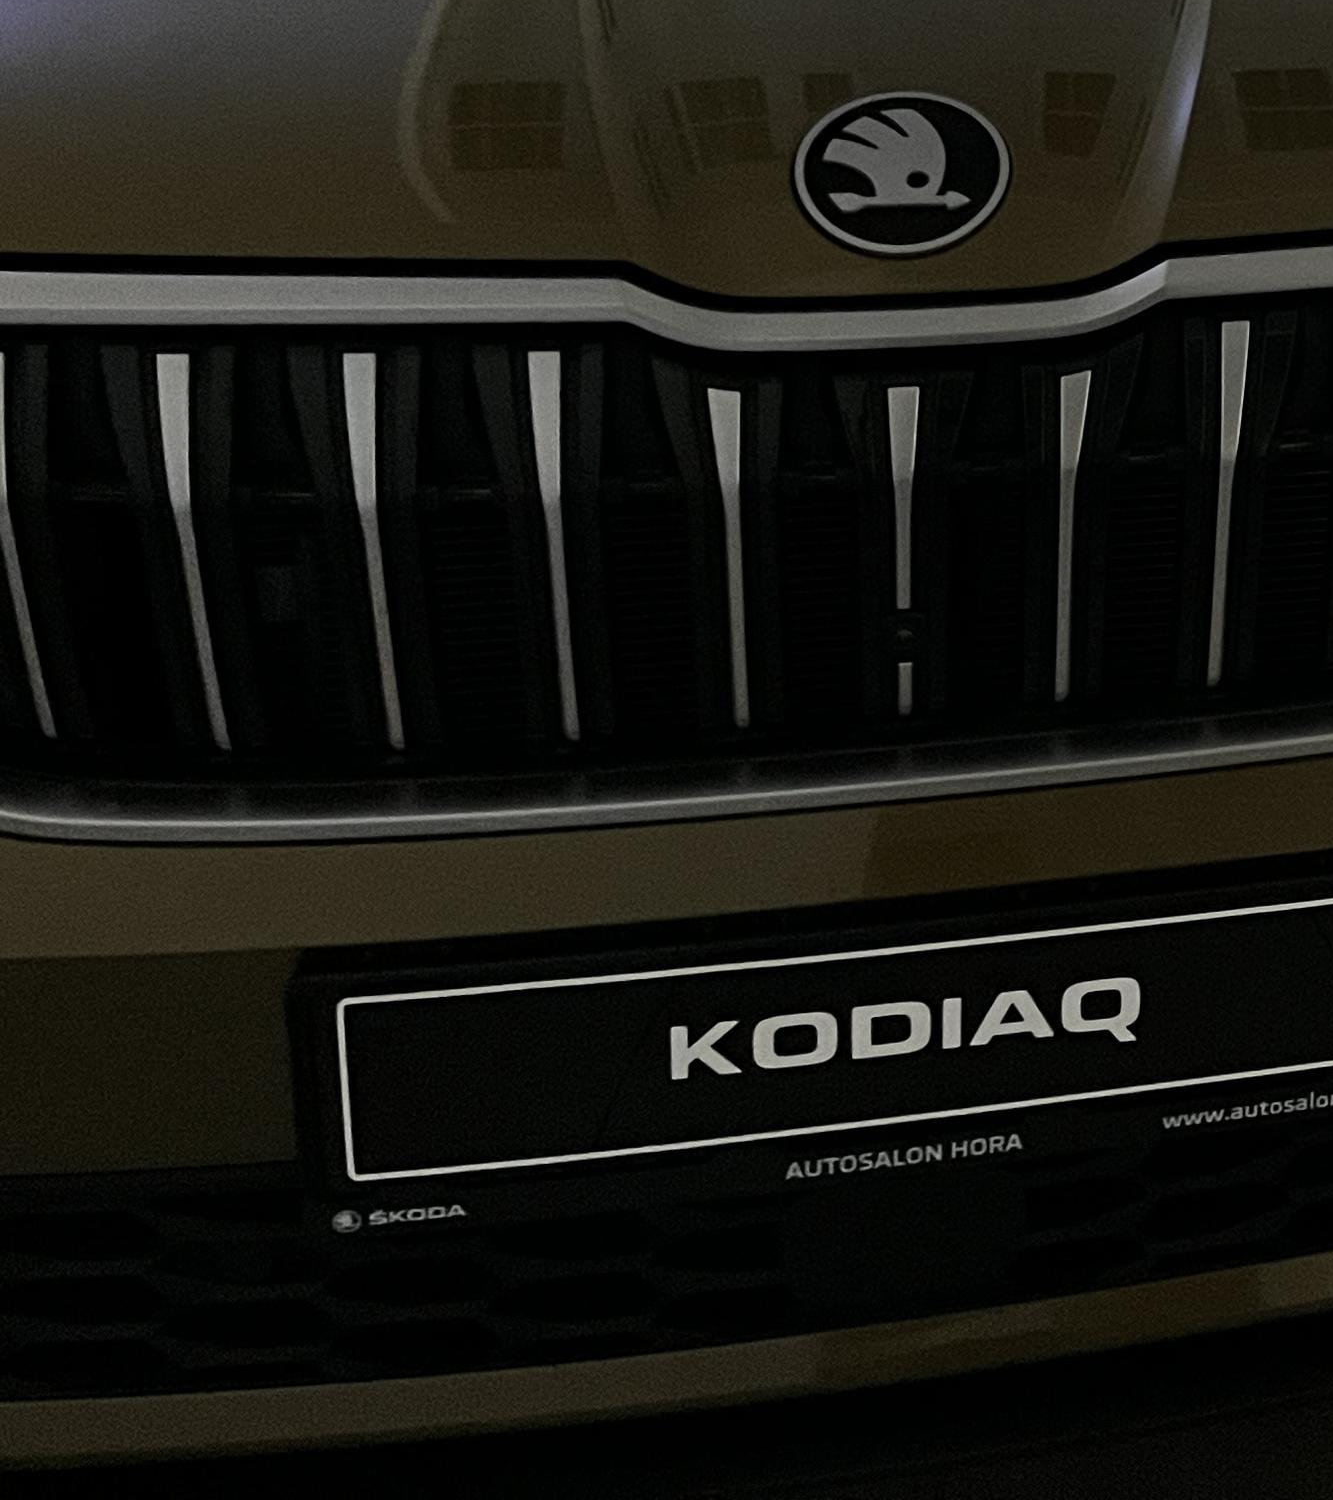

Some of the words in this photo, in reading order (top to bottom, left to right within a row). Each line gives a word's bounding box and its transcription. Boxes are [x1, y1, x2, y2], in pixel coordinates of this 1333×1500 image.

[670, 977, 1141, 1080] KODIAQ
[785, 1144, 943, 1180] AUTOSALON
[951, 1133, 1023, 1159] HORA
[369, 1204, 466, 1226] ŠKODA
